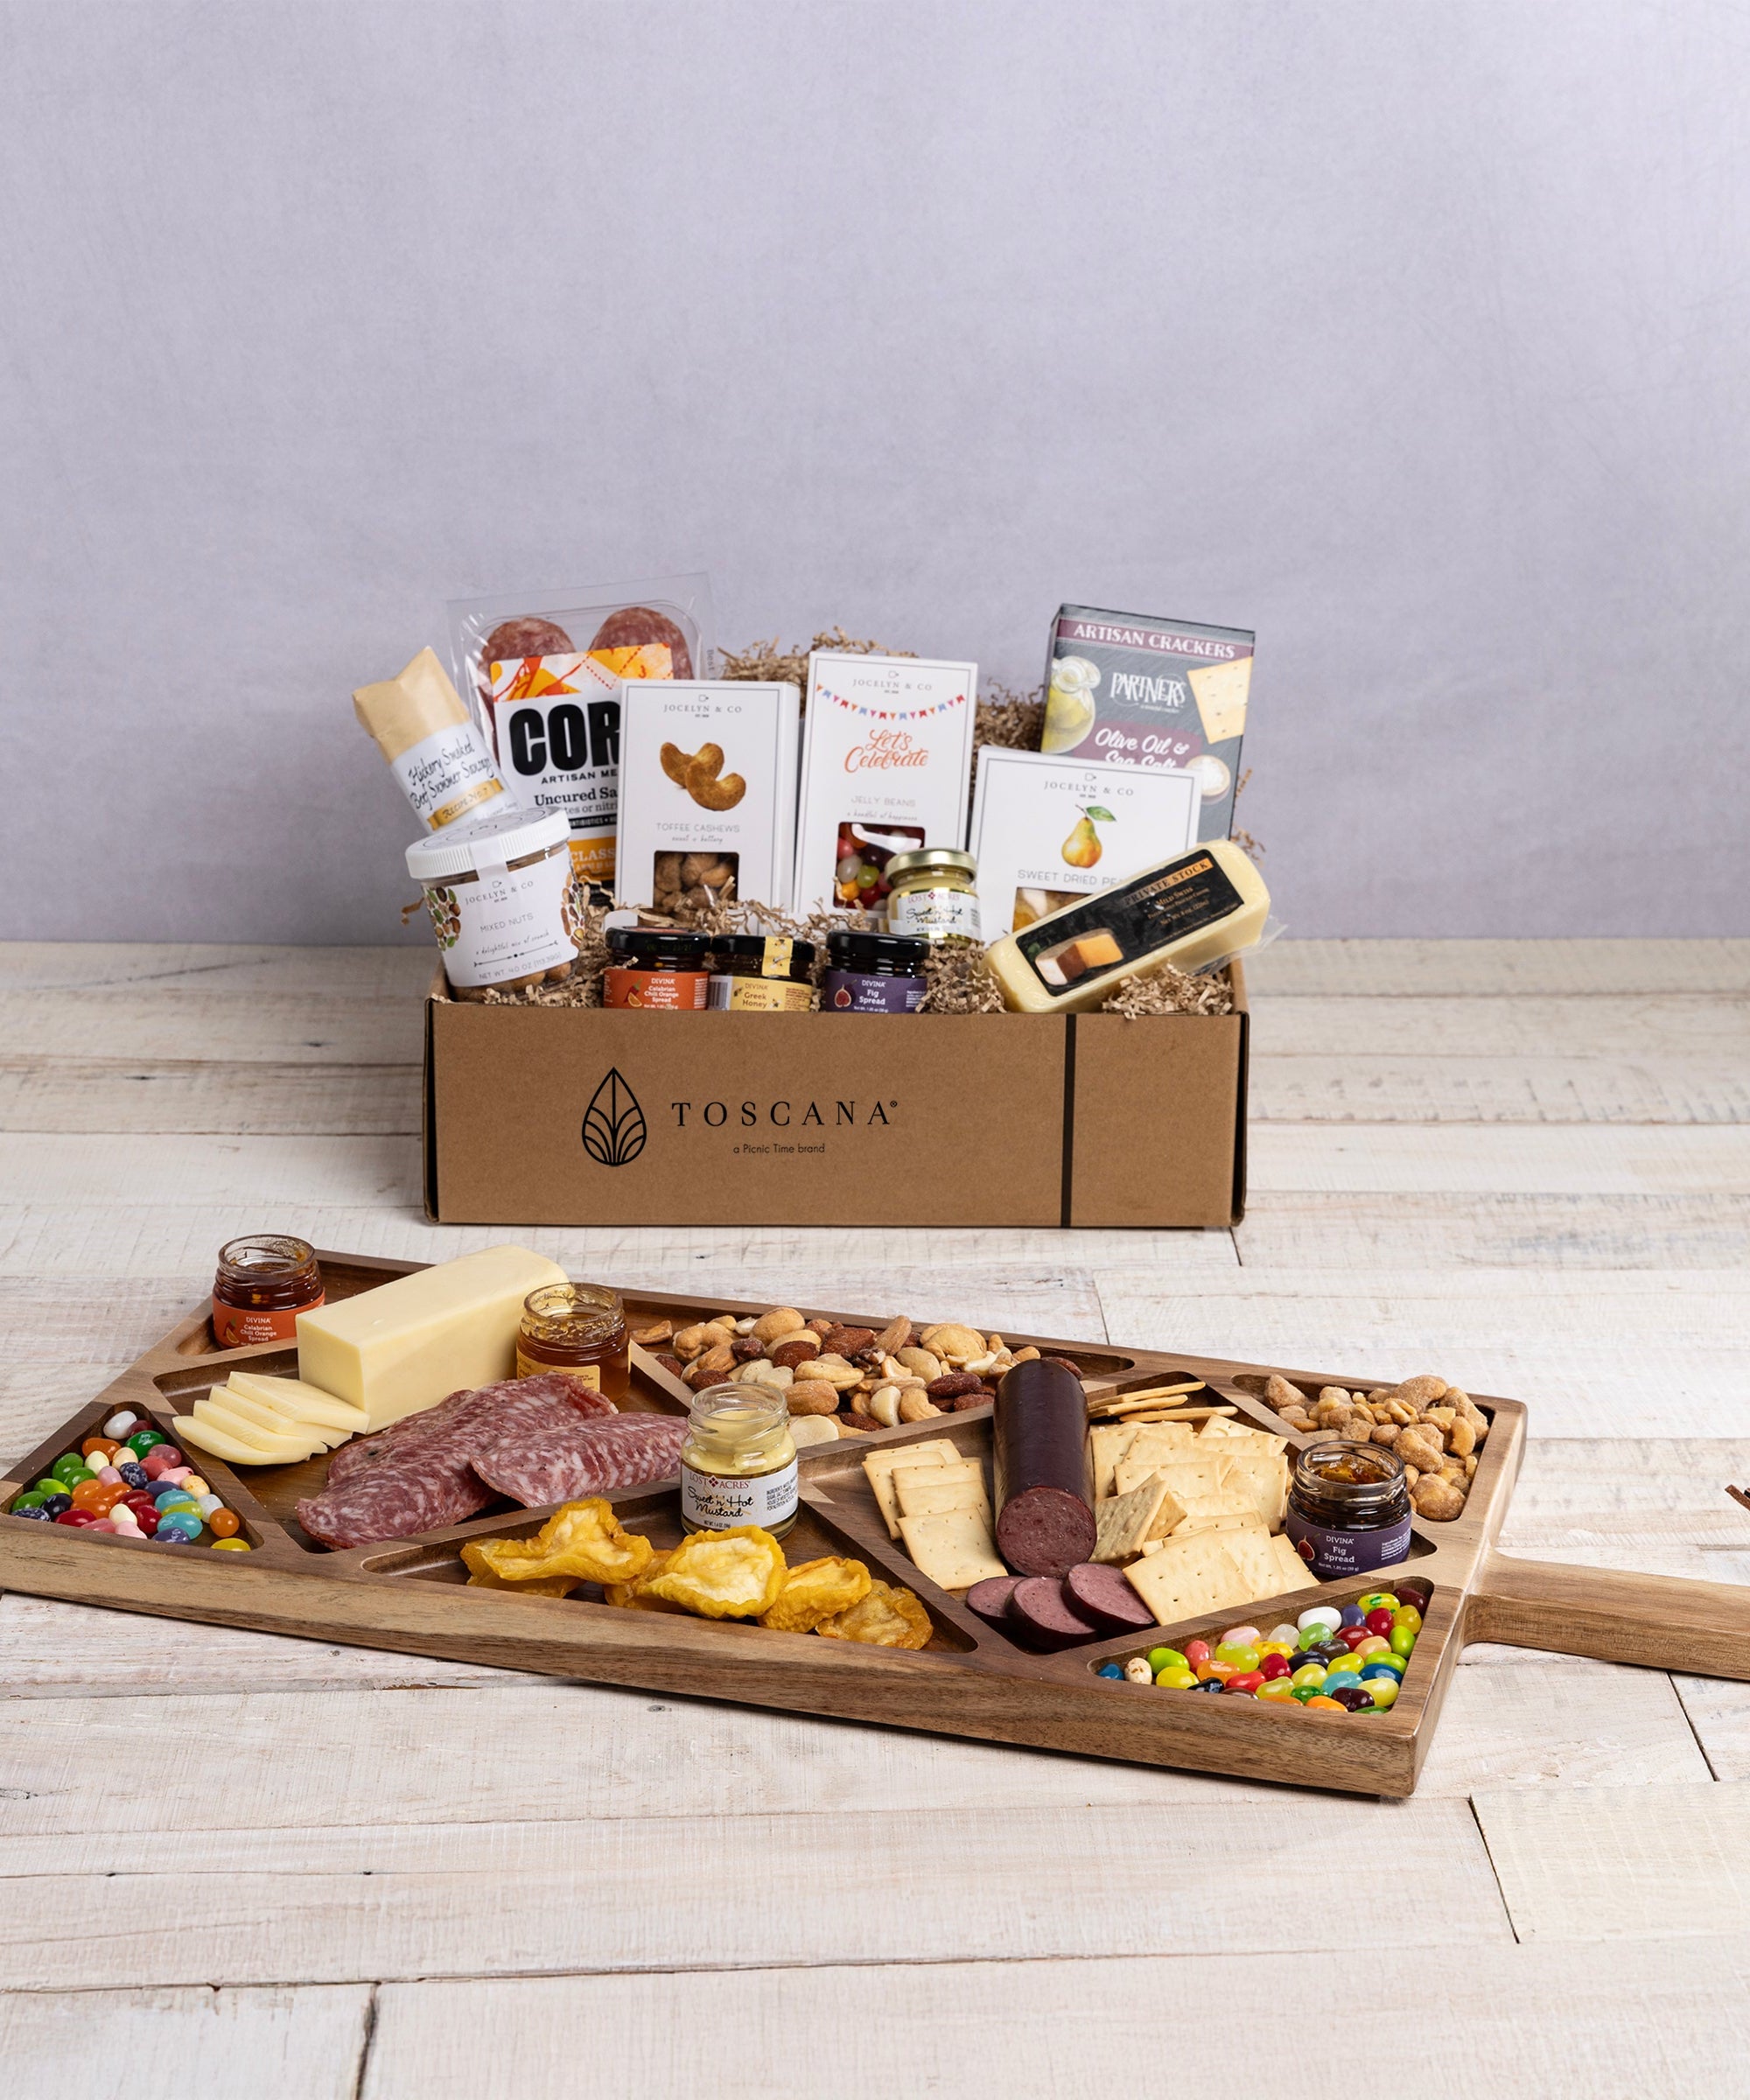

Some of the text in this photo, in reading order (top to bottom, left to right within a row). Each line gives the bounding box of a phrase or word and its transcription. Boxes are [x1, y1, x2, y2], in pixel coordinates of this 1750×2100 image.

[1073, 623, 1236, 660] ARTISAN CRACKERS
[852, 678, 900, 689] JOCELYN
[1110, 671, 1187, 708] PARTNERS
[663, 704, 710, 713] JOCELYN
[865, 729, 913, 752] Let's
[1095, 727, 1190, 756] Olive Oil &
[408, 733, 475, 787] Hickory Smoked
[844, 746, 929, 774] Celebrate
[541, 772, 596, 785] ARTISAN
[410, 783, 434, 811] Beef
[427, 769, 461, 799] Summer
[1044, 780, 1097, 794] JOCELYN
[1116, 788, 1134, 796] CO
[534, 788, 597, 807] Uncured
[850, 795, 916, 808] JELLY BEANS
[581, 803, 594, 814] or
[655, 822, 740, 833] TOFFEE CASHEWS
[1017, 869, 1126, 886] SWEET DRIED PE
[1123, 880, 1171, 906] PRIVATE
[1172, 860, 1208, 883] STOCK
[465, 888, 507, 906] JOCELYN
[521, 880, 534, 890] CO
[480, 912, 534, 933] MIXED NUTS
[744, 991, 766, 1000] Greek
[858, 996, 886, 1005] Spread
[866, 989, 879, 998] Fig
[742, 999, 767, 1009] Honey
[733, 1143, 825, 1154] a Picnic Time brand
[689, 1472, 750, 1490] LOST ACRES
[687, 1485, 714, 1506] Sweet
[726, 1494, 753, 1508] Hot
[695, 1499, 744, 1518] Mustard
[1324, 1552, 1355, 1564] Spread
[1333, 1546, 1347, 1555] Fig
